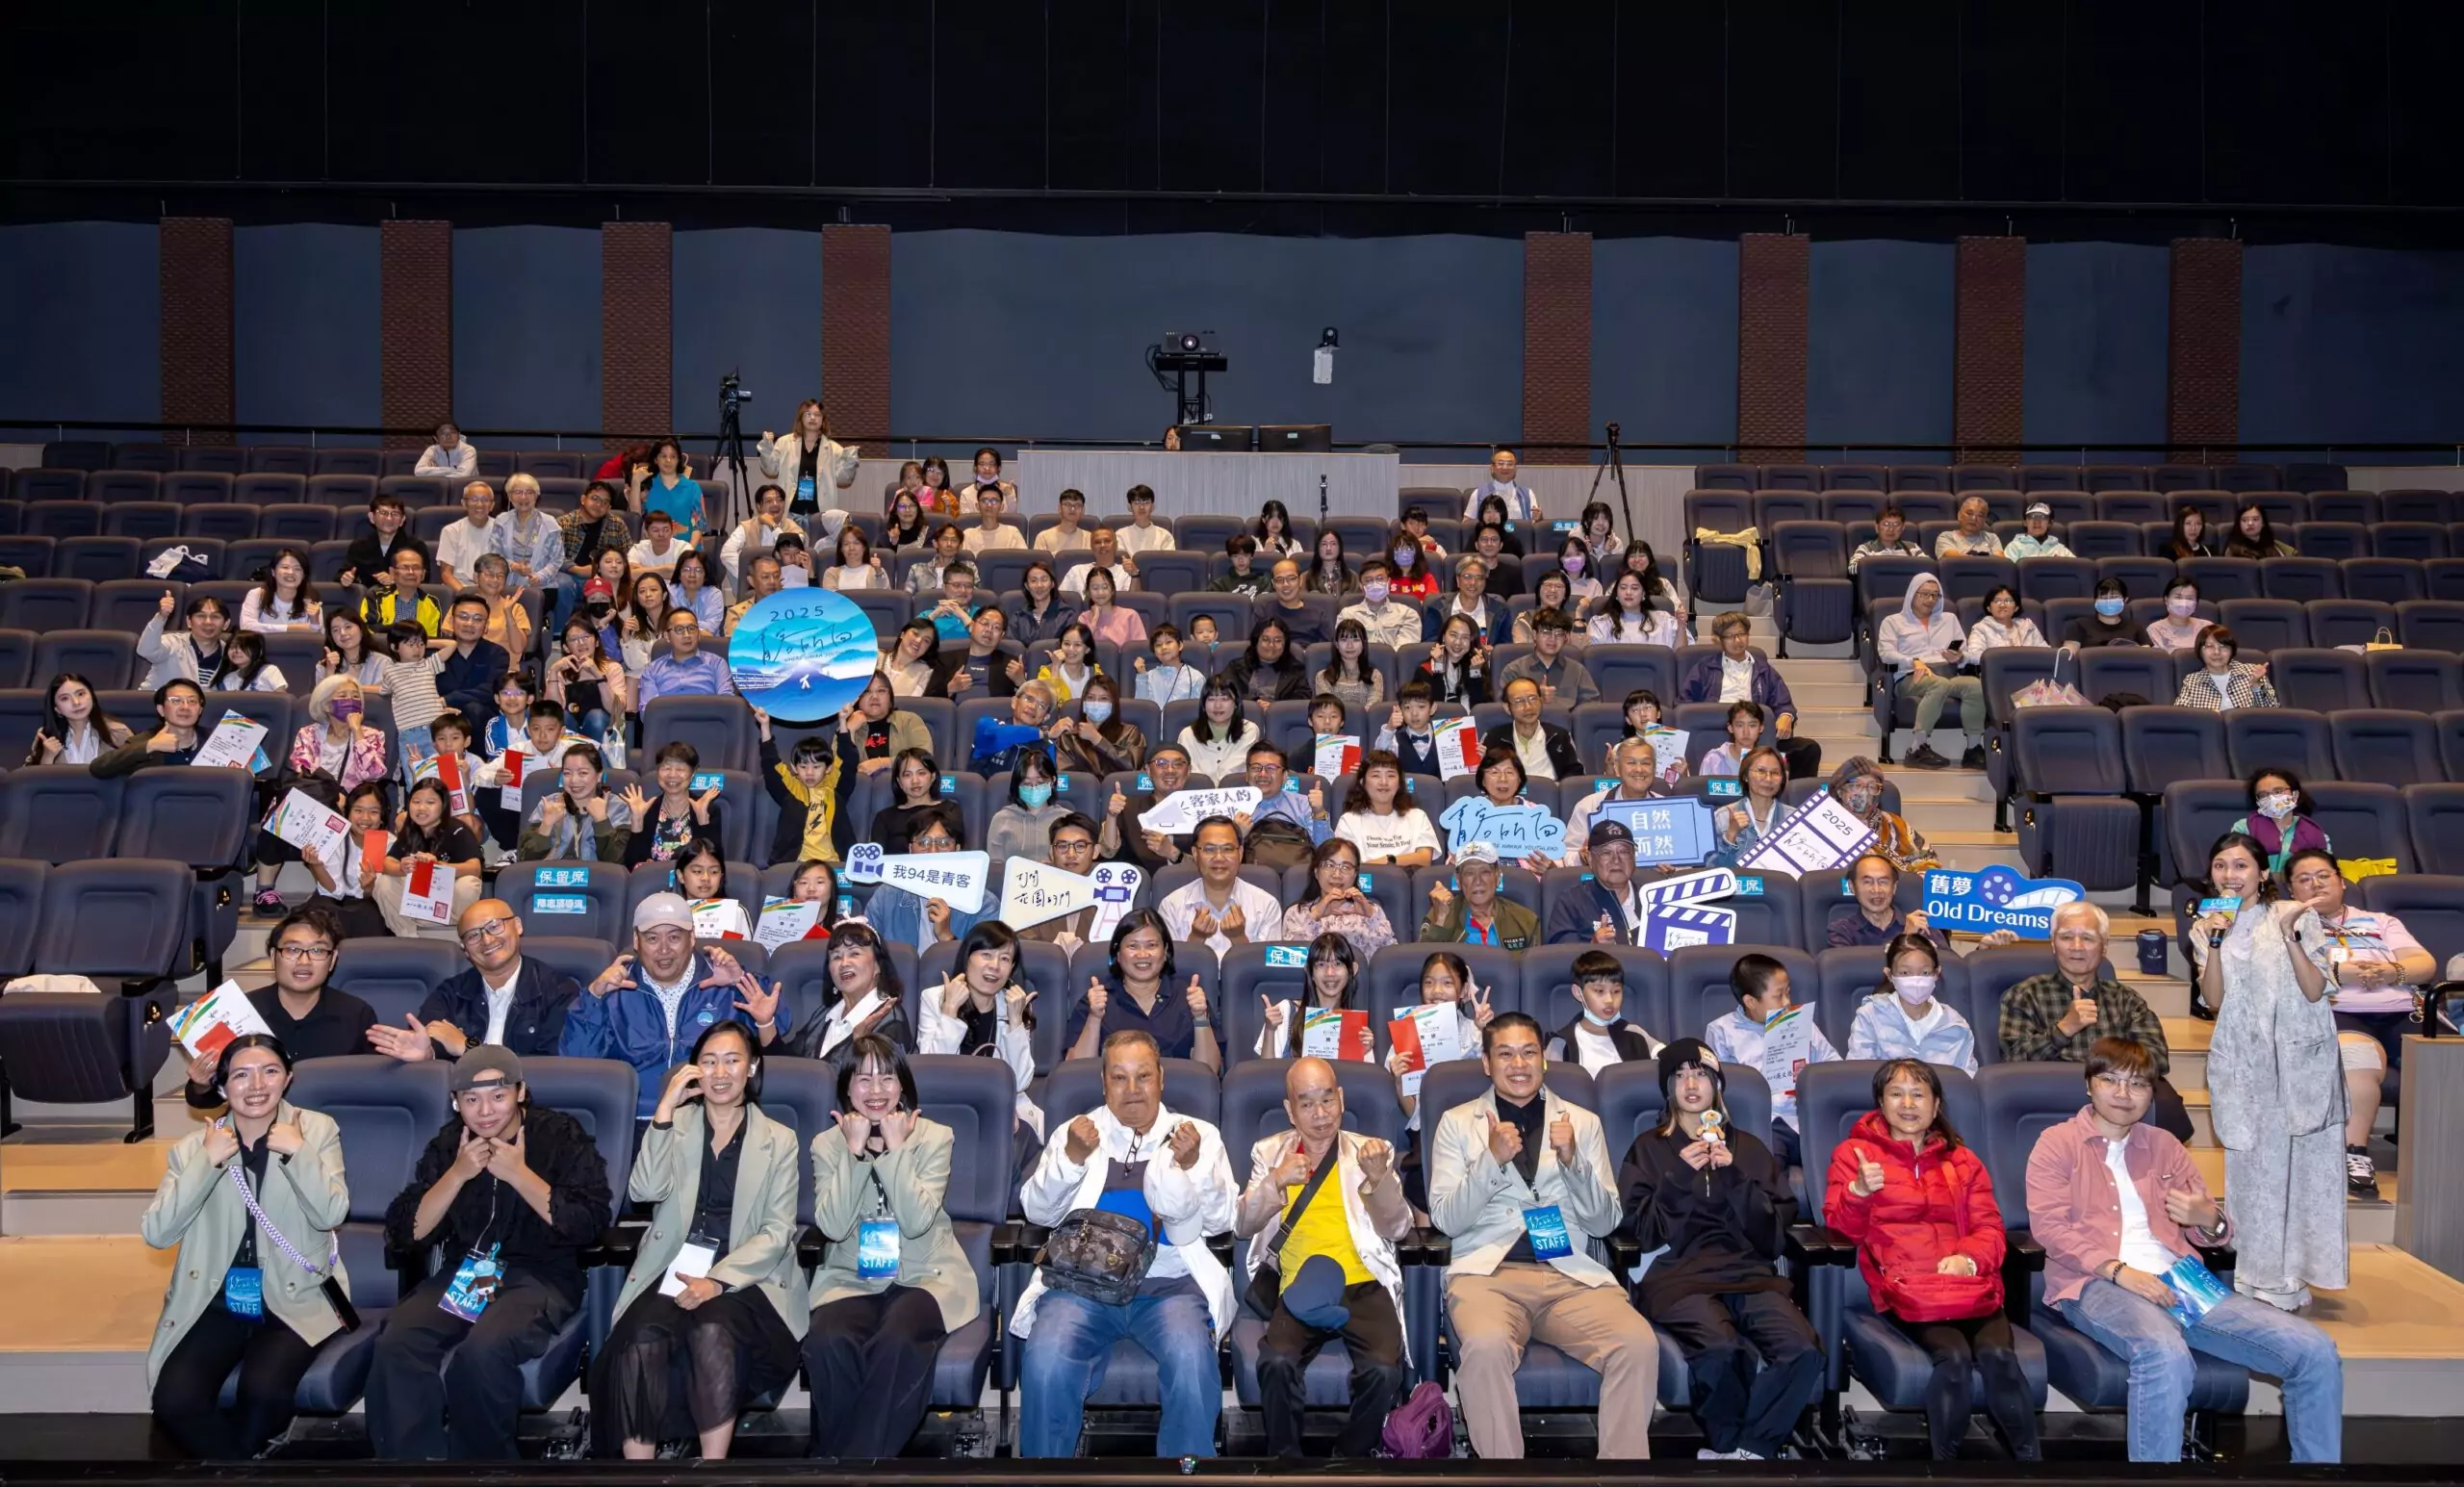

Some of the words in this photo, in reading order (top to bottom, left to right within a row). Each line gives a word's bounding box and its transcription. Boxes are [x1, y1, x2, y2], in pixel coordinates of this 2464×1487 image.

[770, 605, 824, 622] 2025
[695, 775, 721, 788] 留席
[1711, 782, 1741, 795] 保留
[1189, 789, 1251, 808] 客家人的
[1630, 808, 1672, 831] 自然
[1822, 808, 1854, 836] 2025
[1635, 834, 1674, 857] 而然
[540, 870, 585, 885] 保留席
[893, 864, 971, 888] 我94是青客
[1930, 874, 1972, 896] 舊夢
[1928, 900, 1963, 919] Old
[1968, 904, 2049, 929] Dreams
[1270, 949, 1302, 964] 保留
[1535, 1236, 1565, 1250] STAFF
[862, 1254, 893, 1269] STAFF
[230, 1301, 258, 1315] STAFF
[450, 1291, 479, 1311] STAFF
